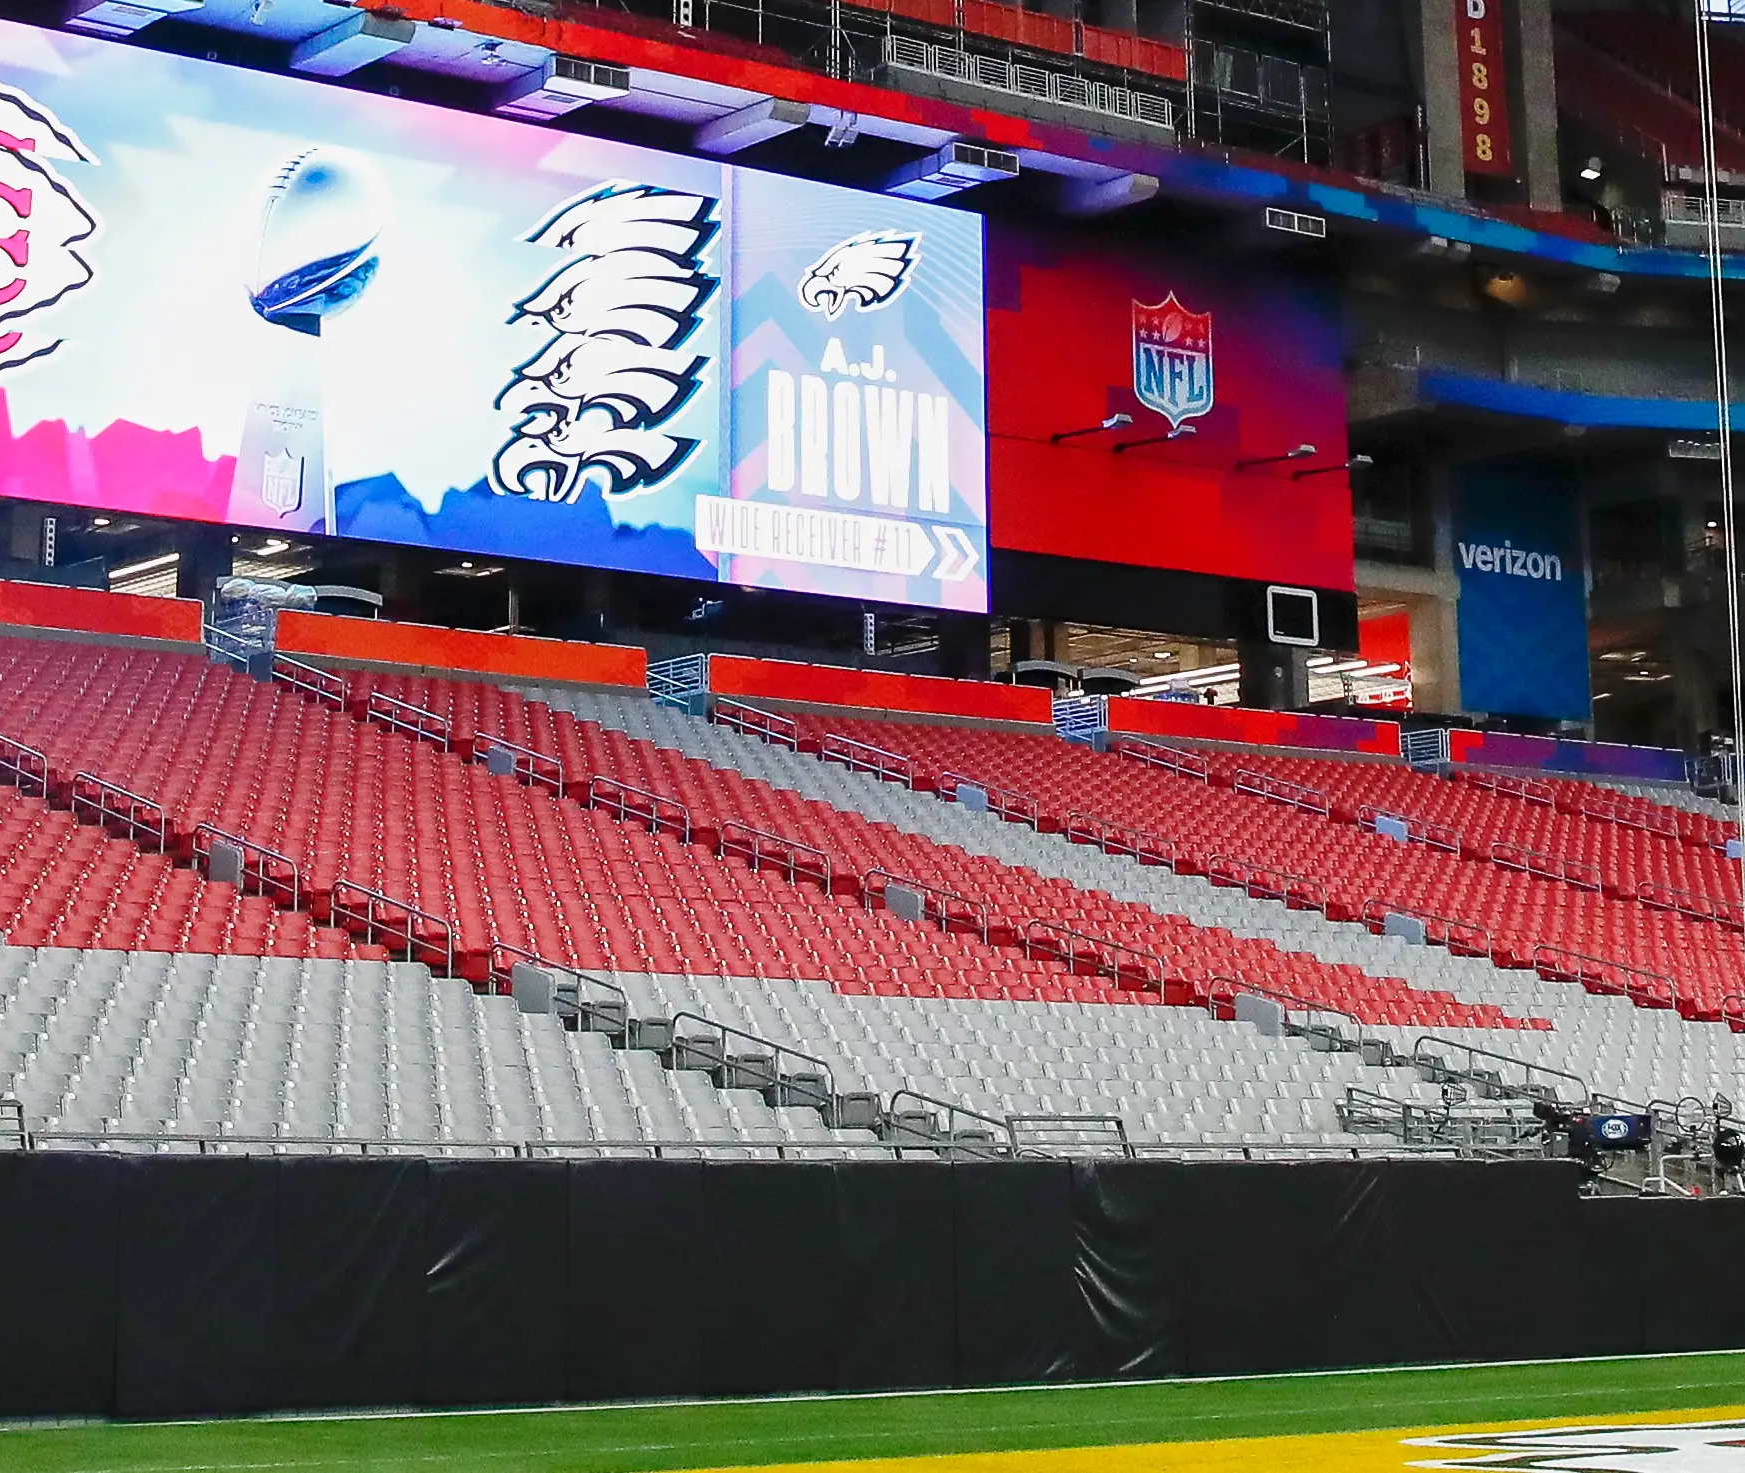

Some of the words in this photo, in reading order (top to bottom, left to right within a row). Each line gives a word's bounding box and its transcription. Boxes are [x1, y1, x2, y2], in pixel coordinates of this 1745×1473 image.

[1469, 27, 1494, 162] 1898
[820, 337, 897, 382] A.J.
[1142, 347, 1205, 408] NFL
[767, 369, 951, 514] BROWN
[708, 502, 761, 551] WIDE
[772, 509, 862, 564] RECEIVER
[873, 524, 914, 570] #11
[1458, 540, 1562, 581] verizon
